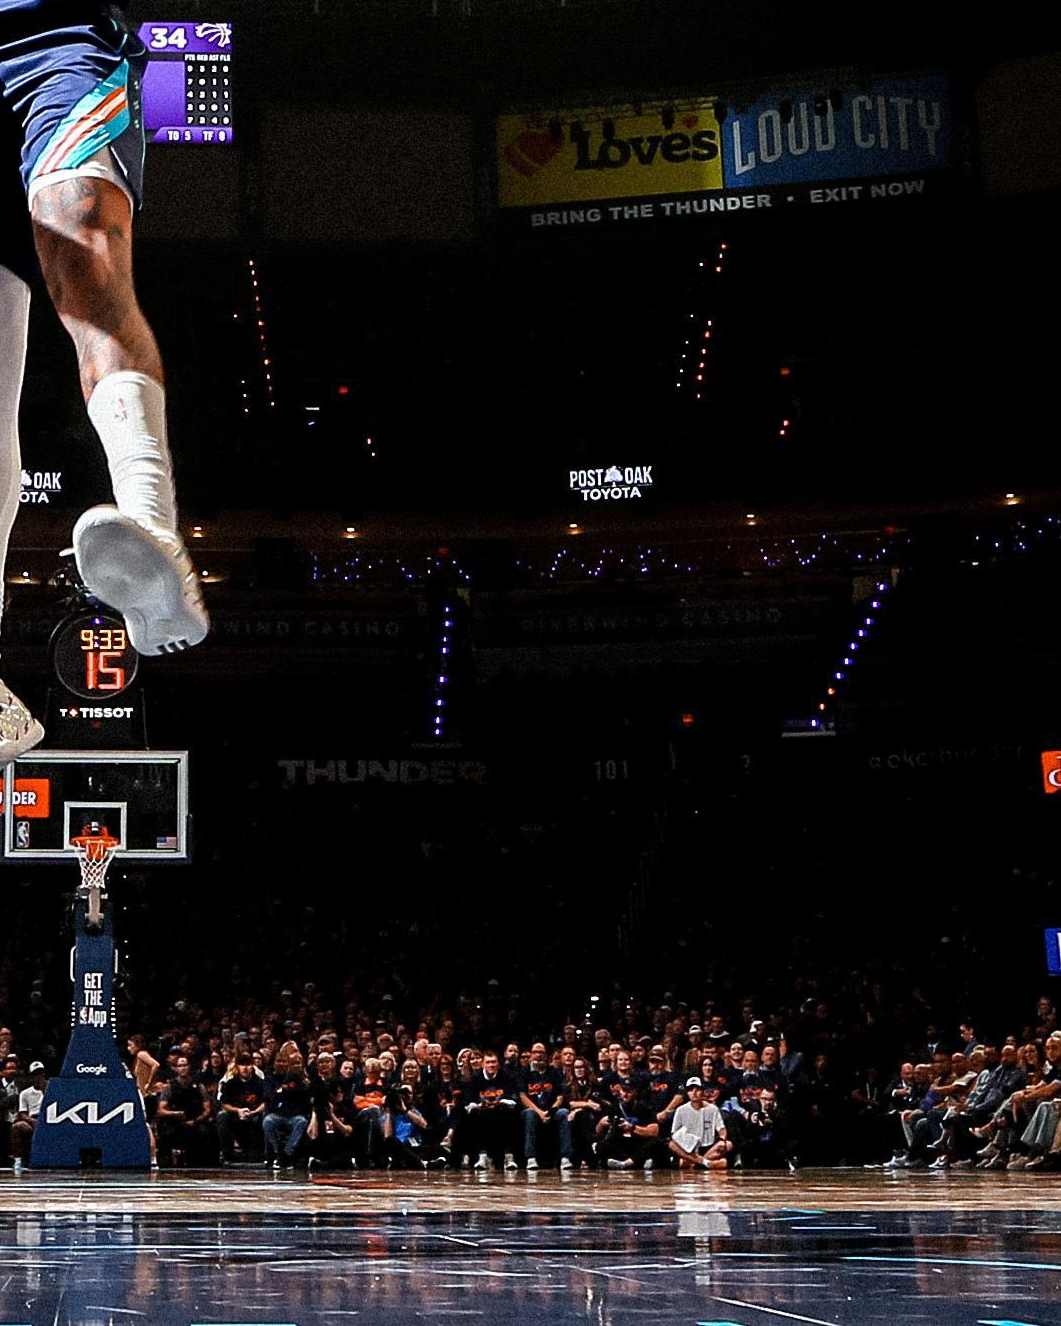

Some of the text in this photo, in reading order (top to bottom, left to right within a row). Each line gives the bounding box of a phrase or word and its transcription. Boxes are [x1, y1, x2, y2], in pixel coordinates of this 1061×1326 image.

[150, 27, 188, 49] 34
[733, 95, 942, 175] LOUD CITY
[531, 179, 926, 228] BRING THE THUNDER EXIT NOW
[33, 472, 62, 490] OAK
[569, 465, 653, 488] POST OAK
[19, 491, 50, 504] OTA
[580, 486, 642, 501] TOYOTA
[80, 629, 126, 650] 9:33
[86, 651, 126, 690] 15
[80, 707, 134, 719] TISSOT
[276, 759, 488, 785] THUNDER
[83, 972, 104, 990] GET
[84, 990, 104, 1007] THE
[88, 1007, 107, 1028] App
[76, 1063, 107, 1075] Google
